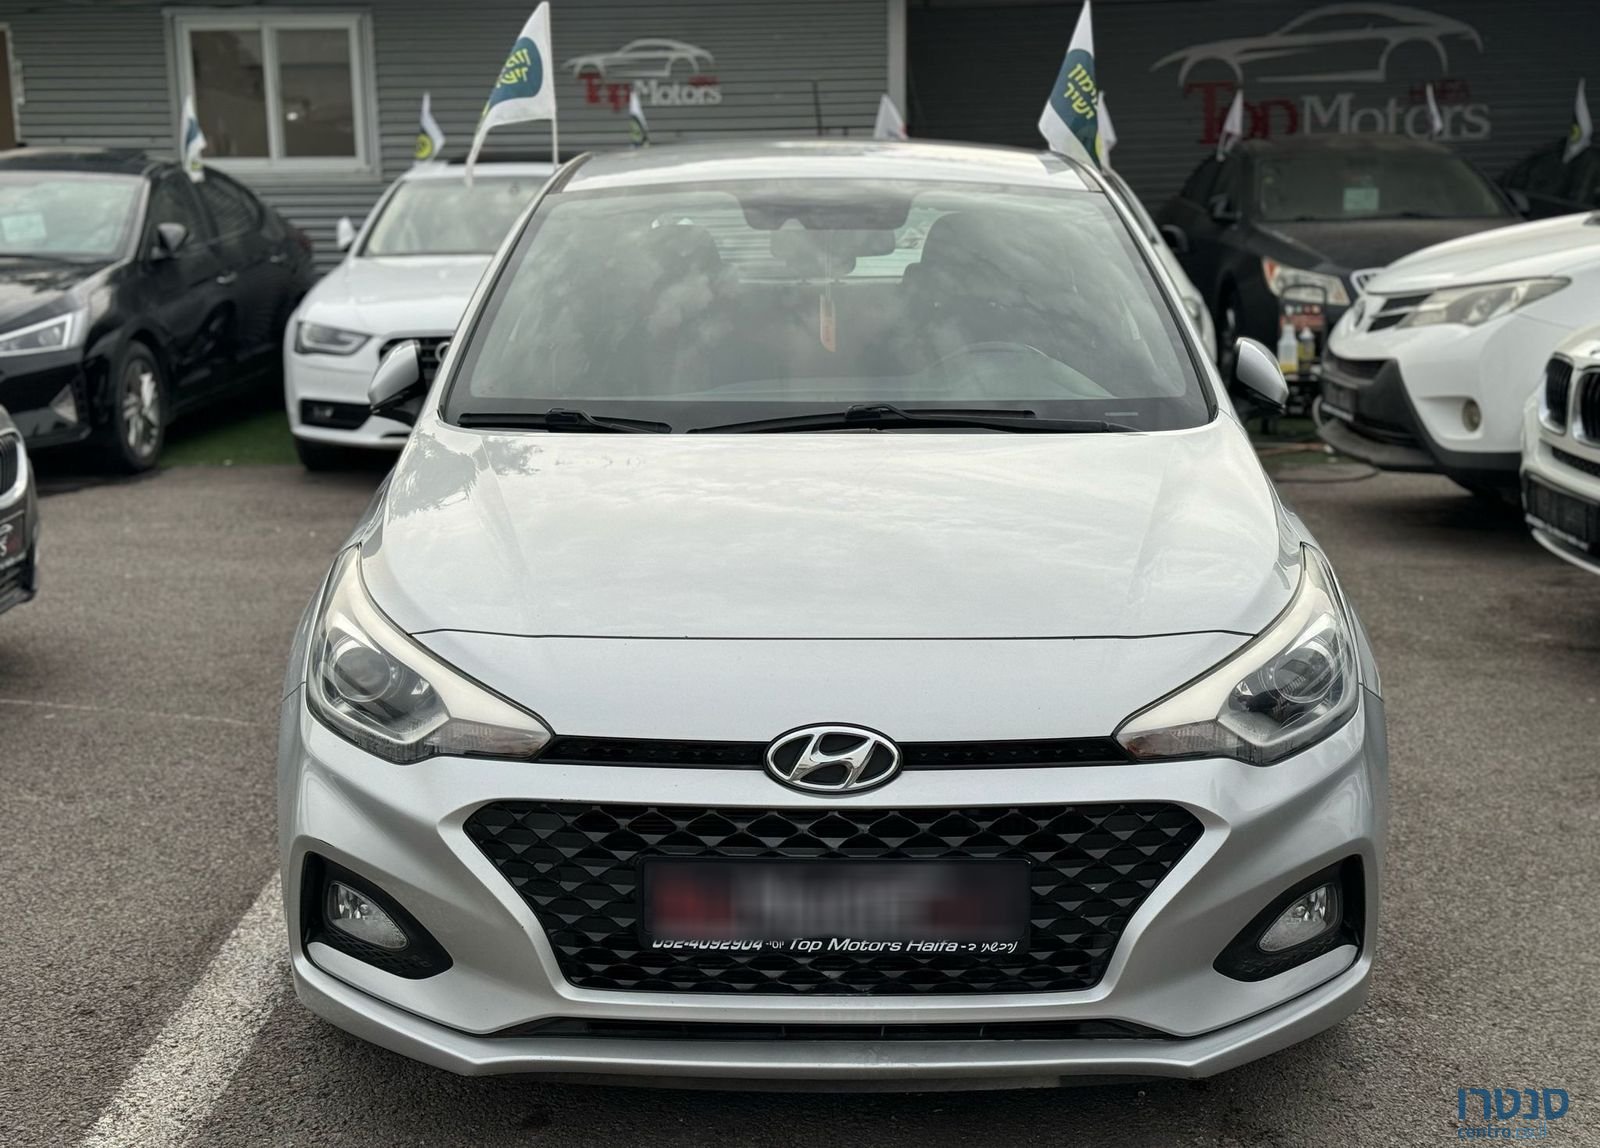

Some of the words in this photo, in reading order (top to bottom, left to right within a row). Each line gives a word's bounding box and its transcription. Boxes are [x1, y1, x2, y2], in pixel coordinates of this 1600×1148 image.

[789, 938, 823, 953] Top
[827, 938, 903, 952] Motors
[905, 939, 959, 952] Haifa
